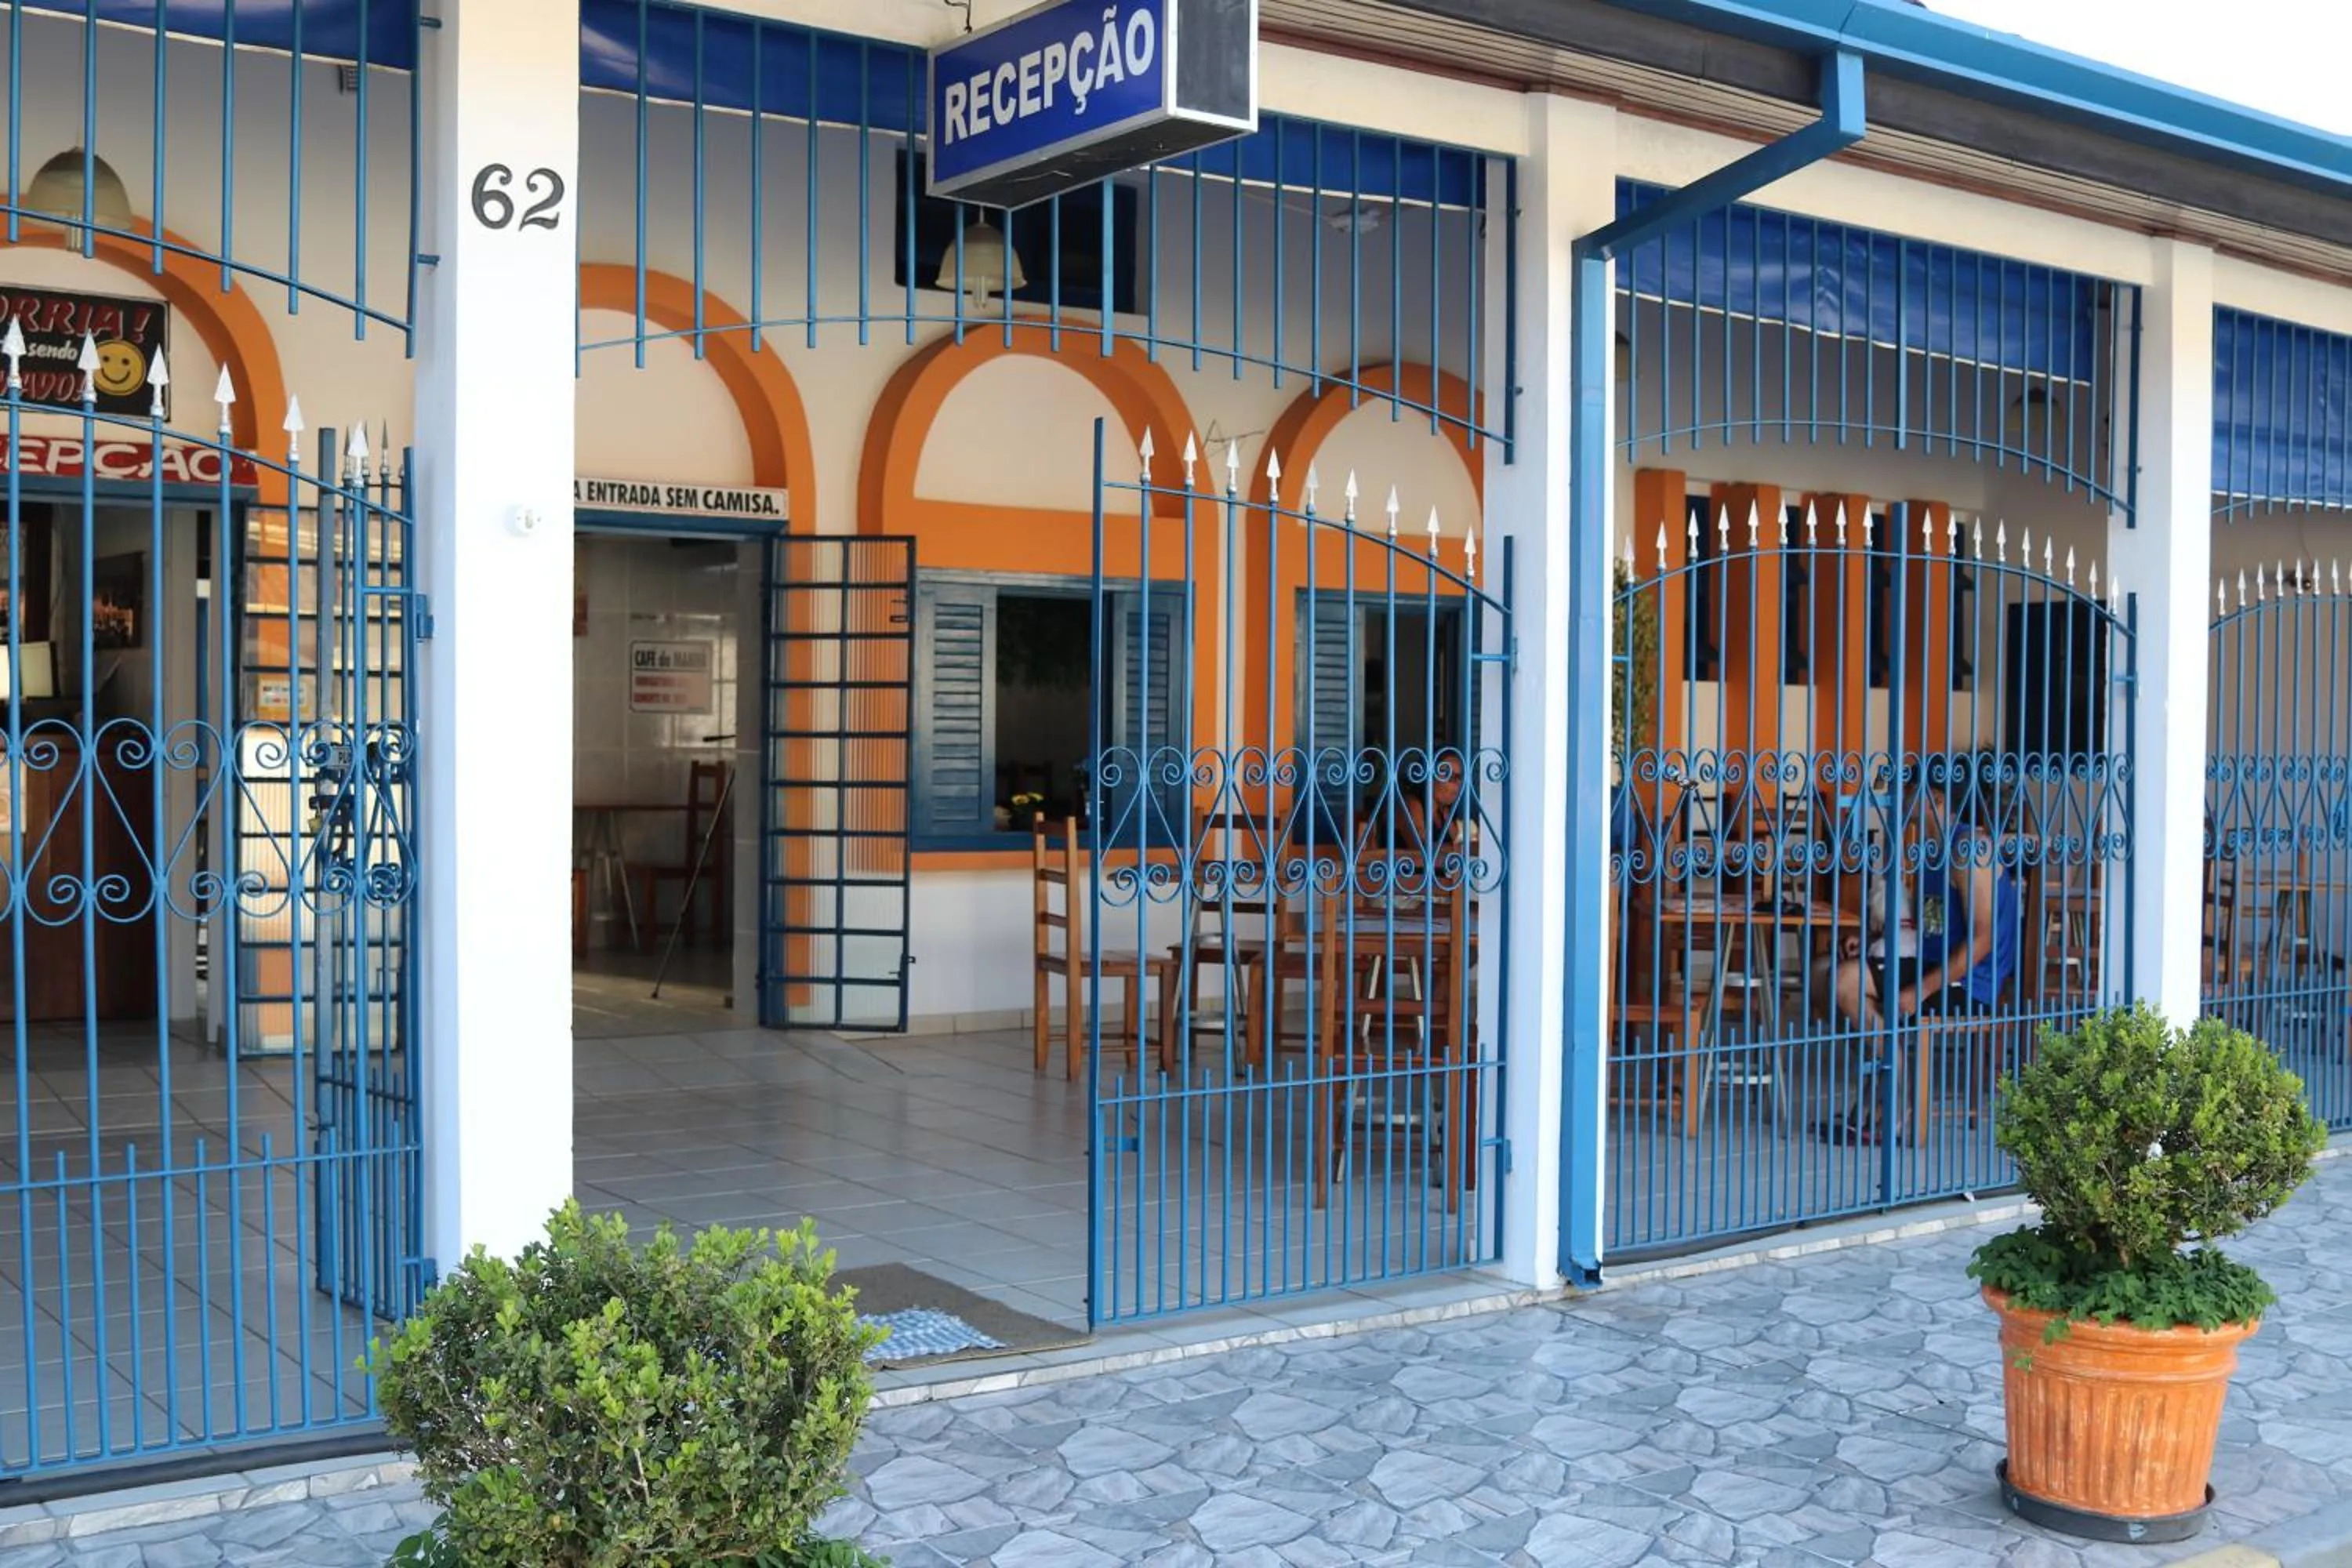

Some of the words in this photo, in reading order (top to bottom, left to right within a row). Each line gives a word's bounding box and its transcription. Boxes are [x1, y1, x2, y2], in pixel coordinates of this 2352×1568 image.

[944, 4, 1155, 146] RECEPÇÃO
[471, 162, 564, 231] 62
[27, 339, 78, 361] sendo
[587, 481, 661, 506] ENTRADA
[666, 487, 699, 509] SEM
[703, 489, 780, 515] CAMISA.
